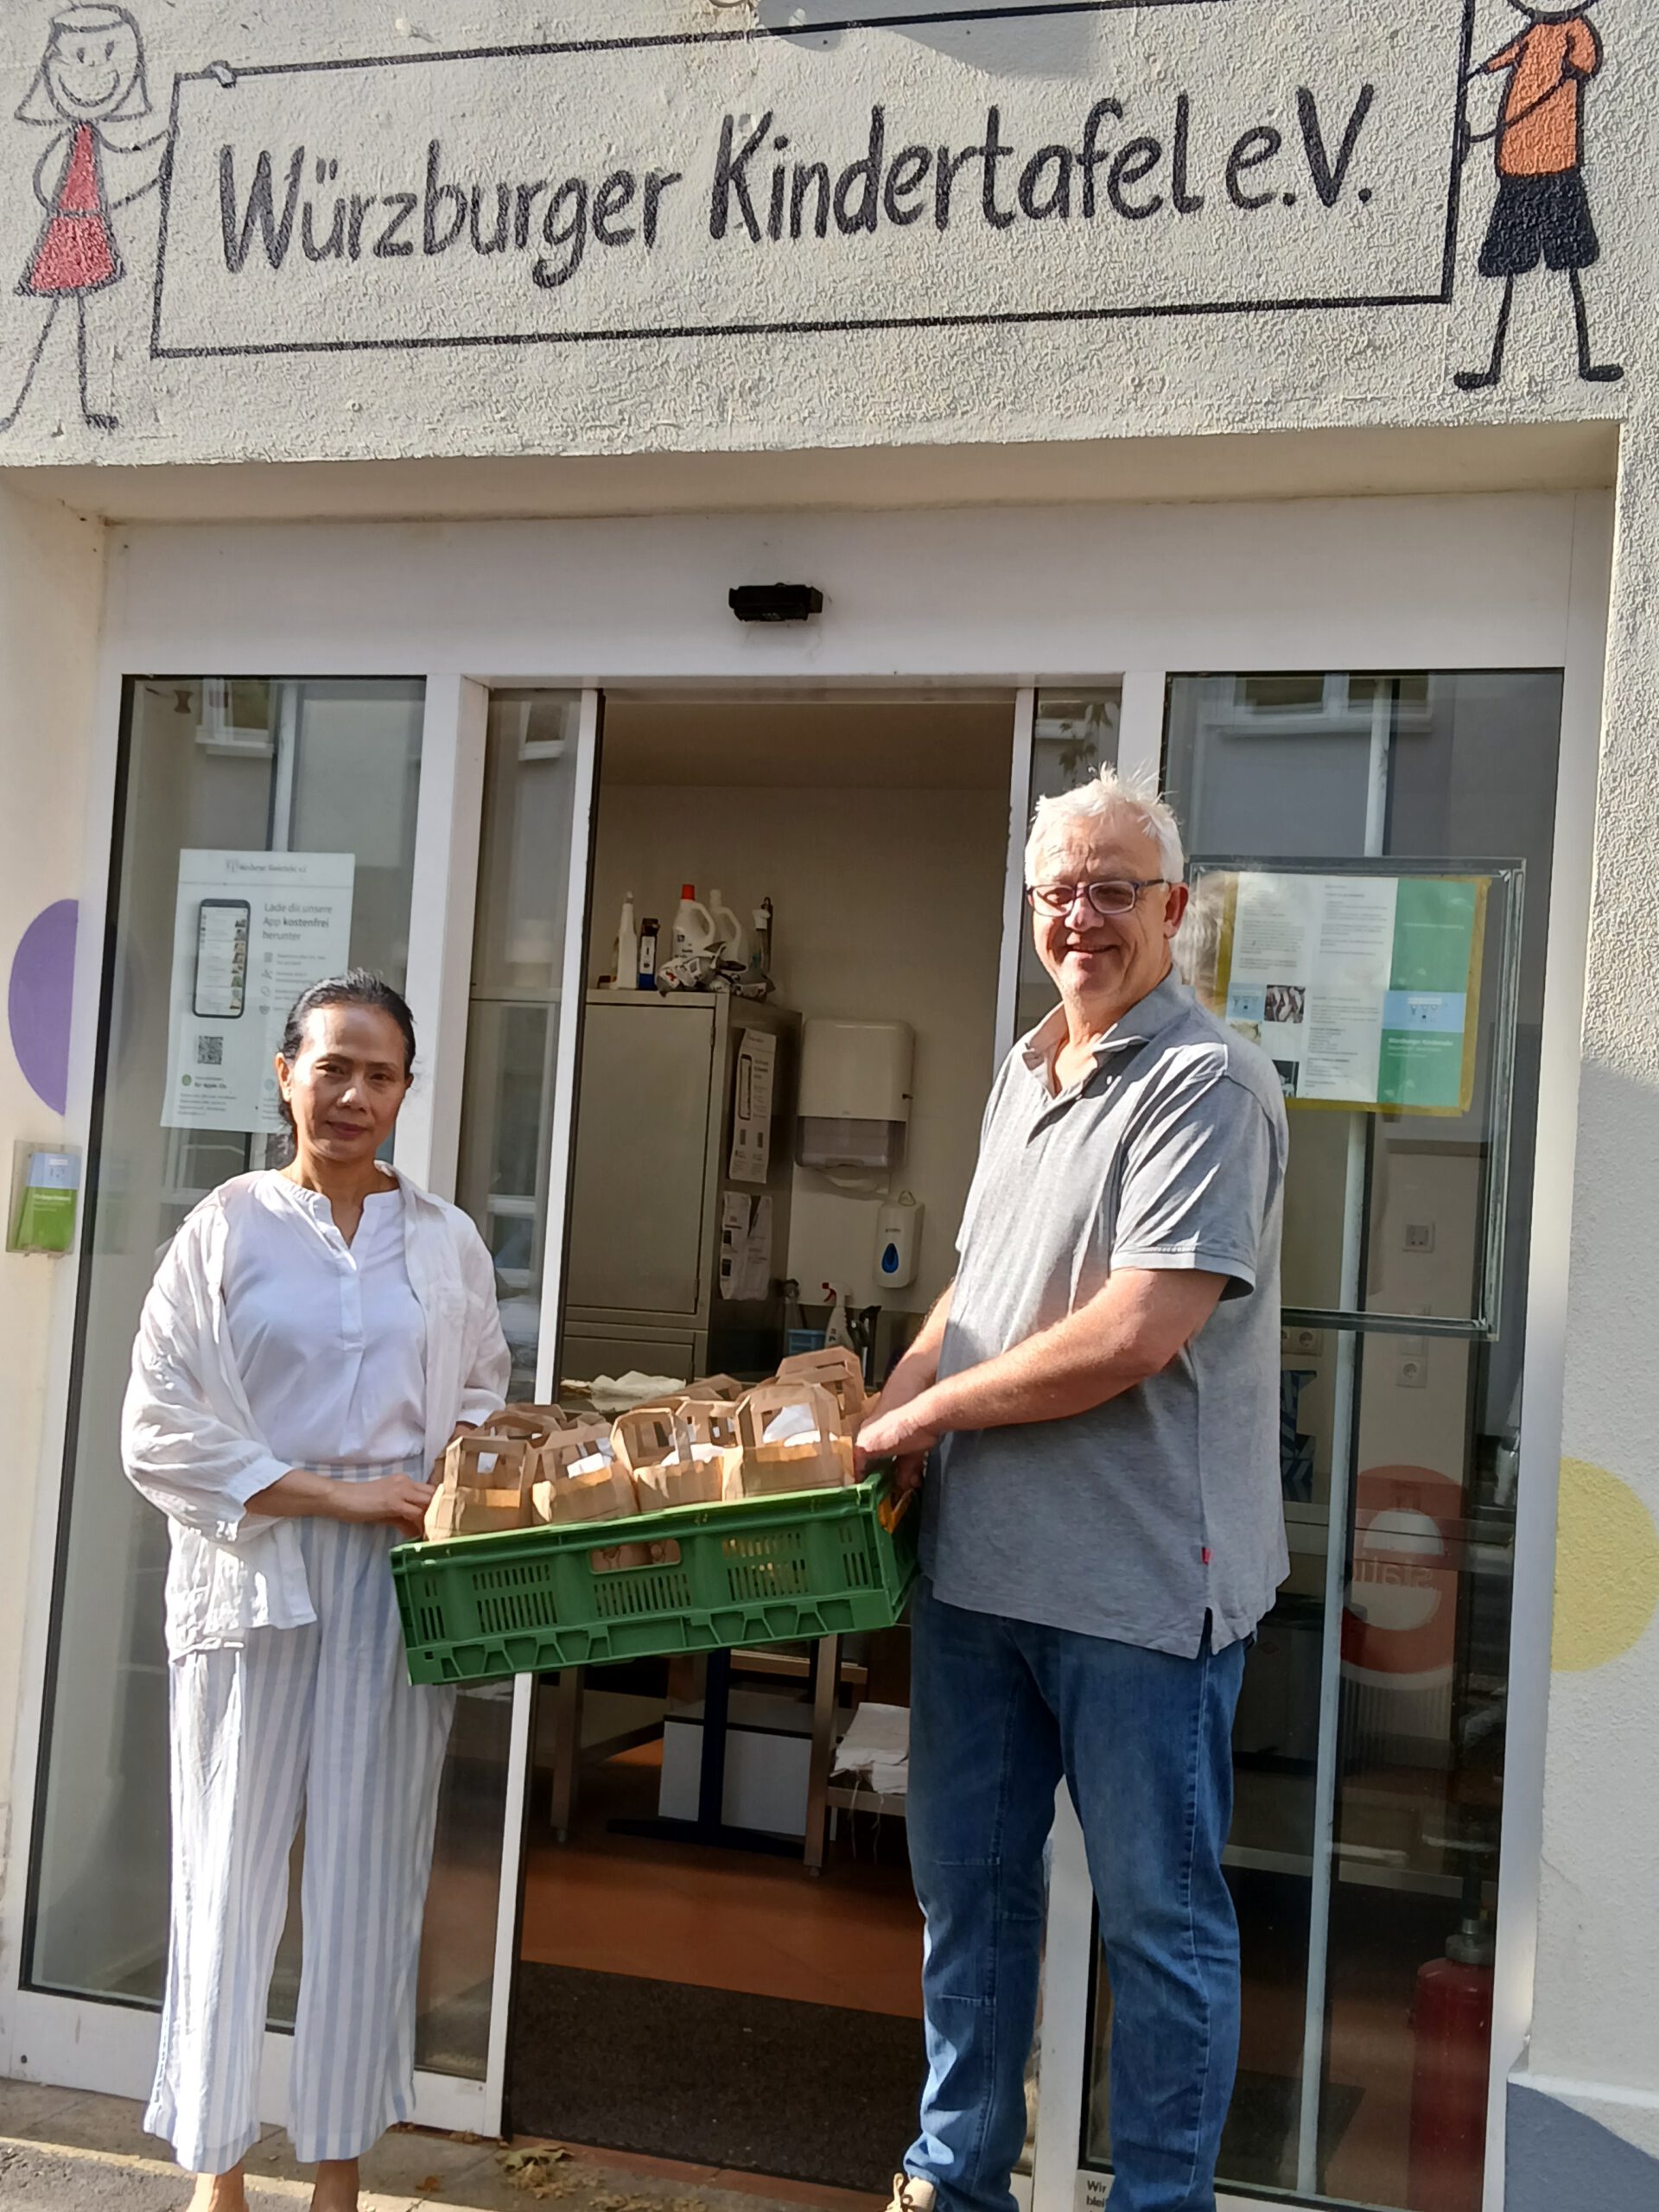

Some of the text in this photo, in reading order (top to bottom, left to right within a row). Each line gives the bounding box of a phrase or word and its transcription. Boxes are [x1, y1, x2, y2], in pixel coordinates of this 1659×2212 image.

[219, 83, 1376, 290] Würzburger Kindertafel e.V.
[283, 917, 329, 928] kostenfrei
[1087, 2180, 1107, 2193] Wir
